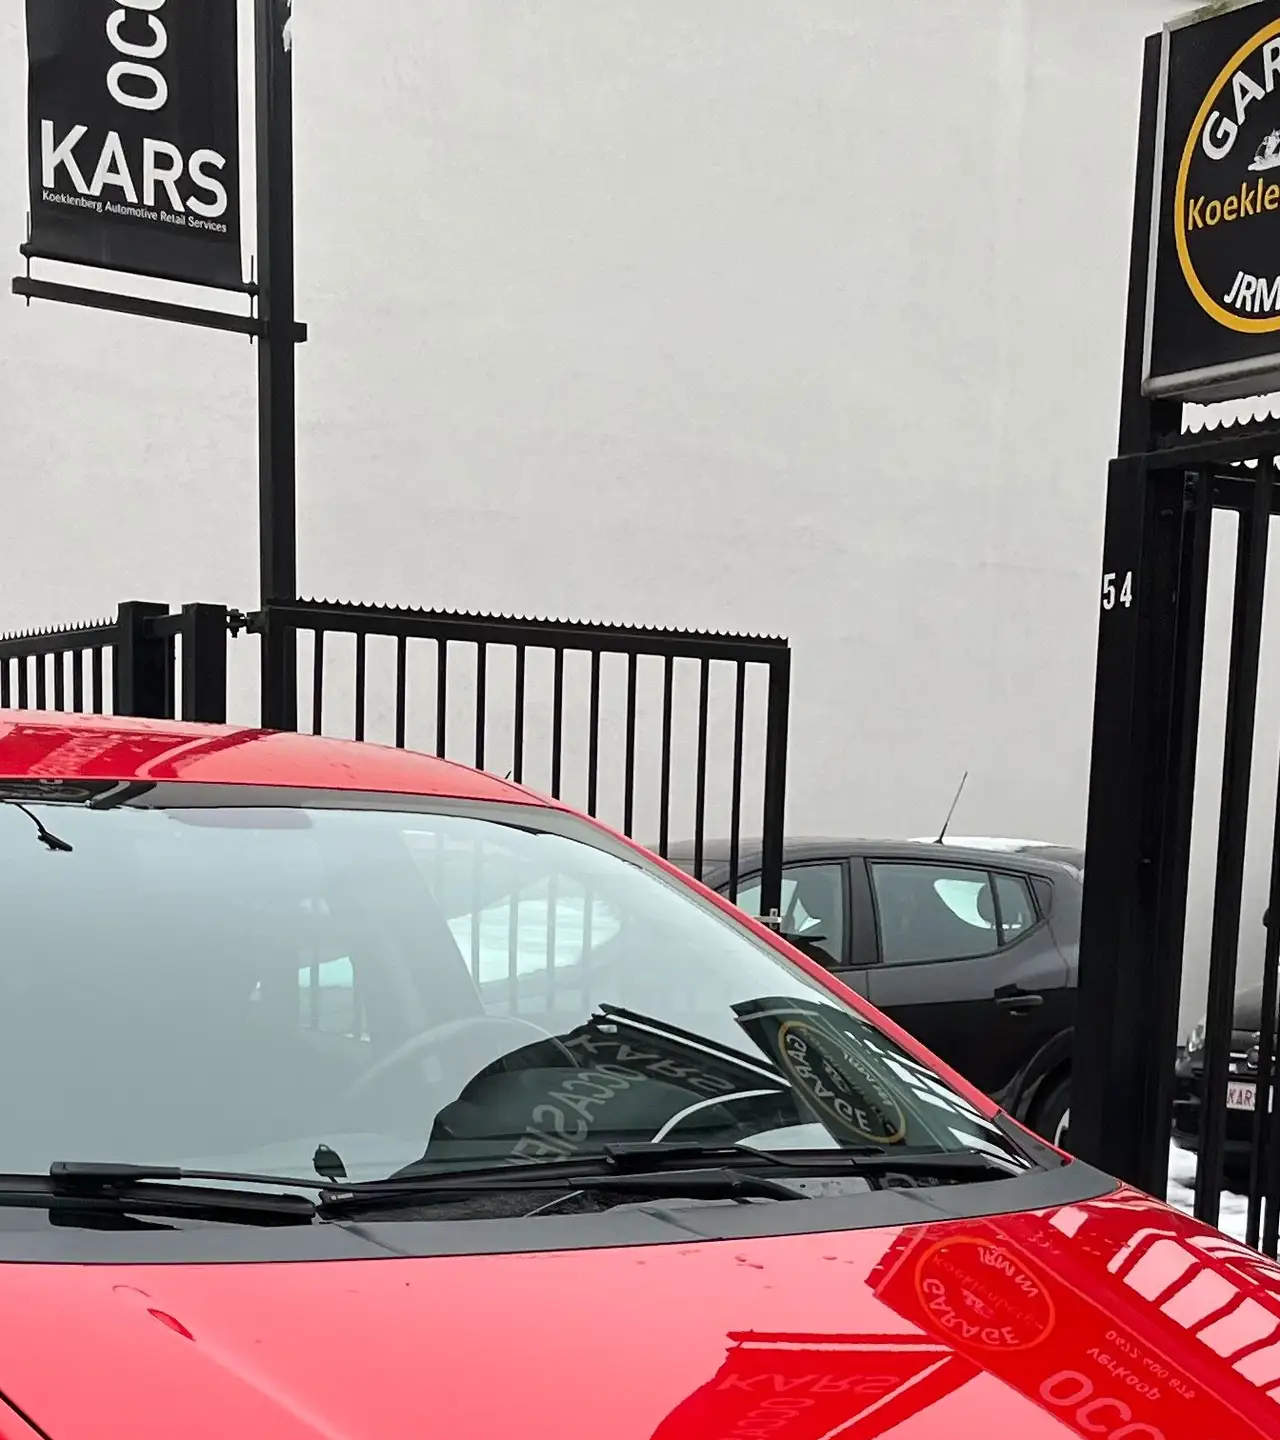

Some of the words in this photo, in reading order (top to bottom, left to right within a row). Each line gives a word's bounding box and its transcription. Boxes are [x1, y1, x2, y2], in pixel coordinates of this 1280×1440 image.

[106, 0, 168, 111] OC
[41, 119, 229, 218] KARS
[42, 190, 103, 213] Koeklenberg
[105, 201, 158, 221] Automotive
[160, 210, 186, 226] Retail
[188, 215, 227, 233] Services
[1102, 570, 1133, 610] 54
[1227, 1088, 1253, 1107] KAR
